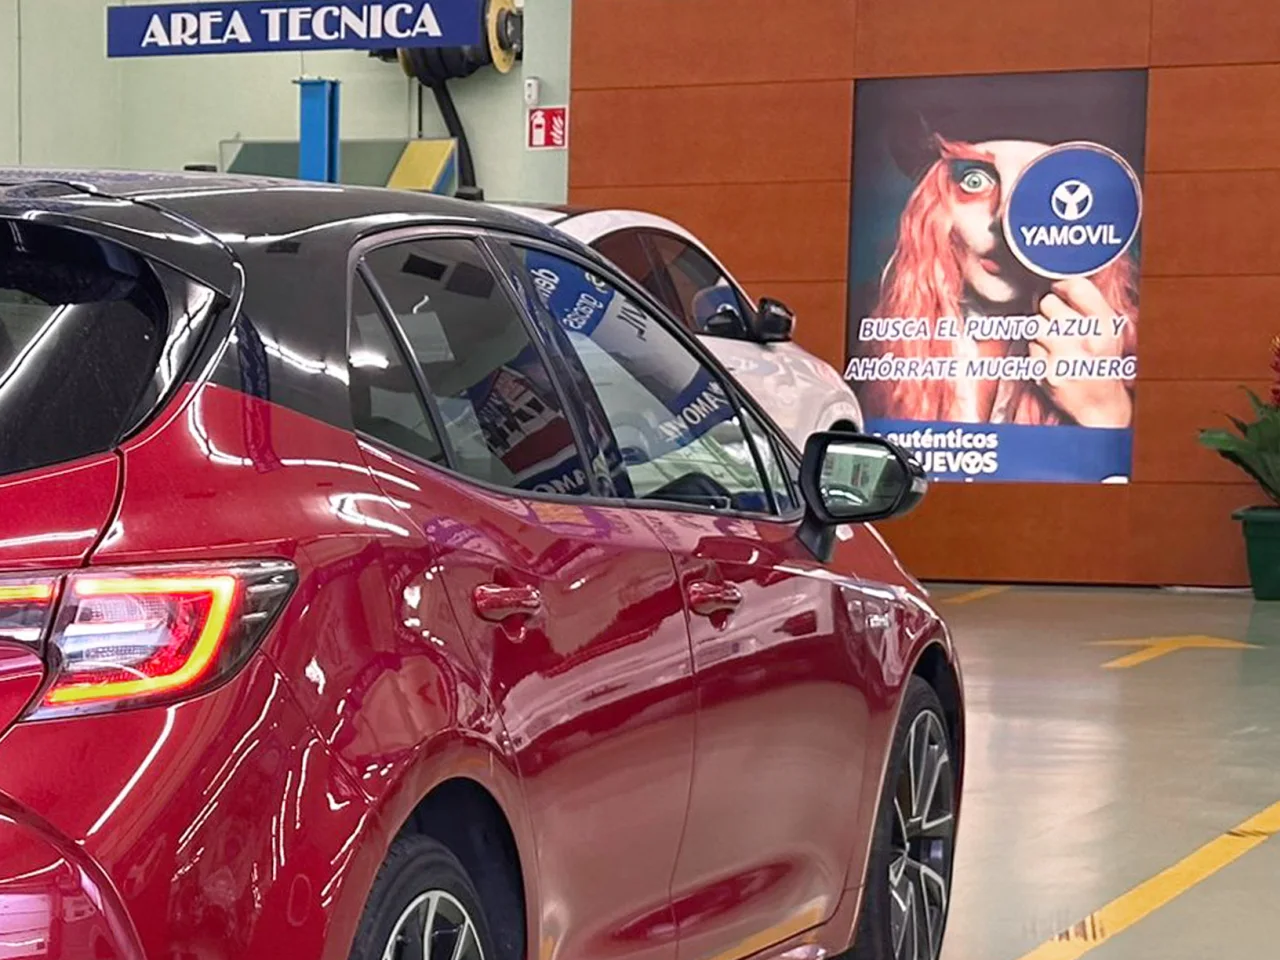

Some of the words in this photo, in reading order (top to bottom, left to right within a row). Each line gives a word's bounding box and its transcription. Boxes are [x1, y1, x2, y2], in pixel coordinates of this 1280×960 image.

[141, 10, 251, 47] AREA
[261, 3, 442, 42] TECNICA
[1020, 224, 1122, 246] YAMOVIL
[861, 319, 929, 338] BUSCA
[937, 319, 958, 337] EL
[966, 318, 1040, 337] PUNTO
[1046, 318, 1102, 337] AZUL
[1111, 318, 1125, 336] Y
[845, 353, 958, 378] AHÓRRATE
[965, 358, 1047, 378] MUCHO
[1055, 358, 1137, 378] DINERO
[887, 428, 999, 449] auténticos
